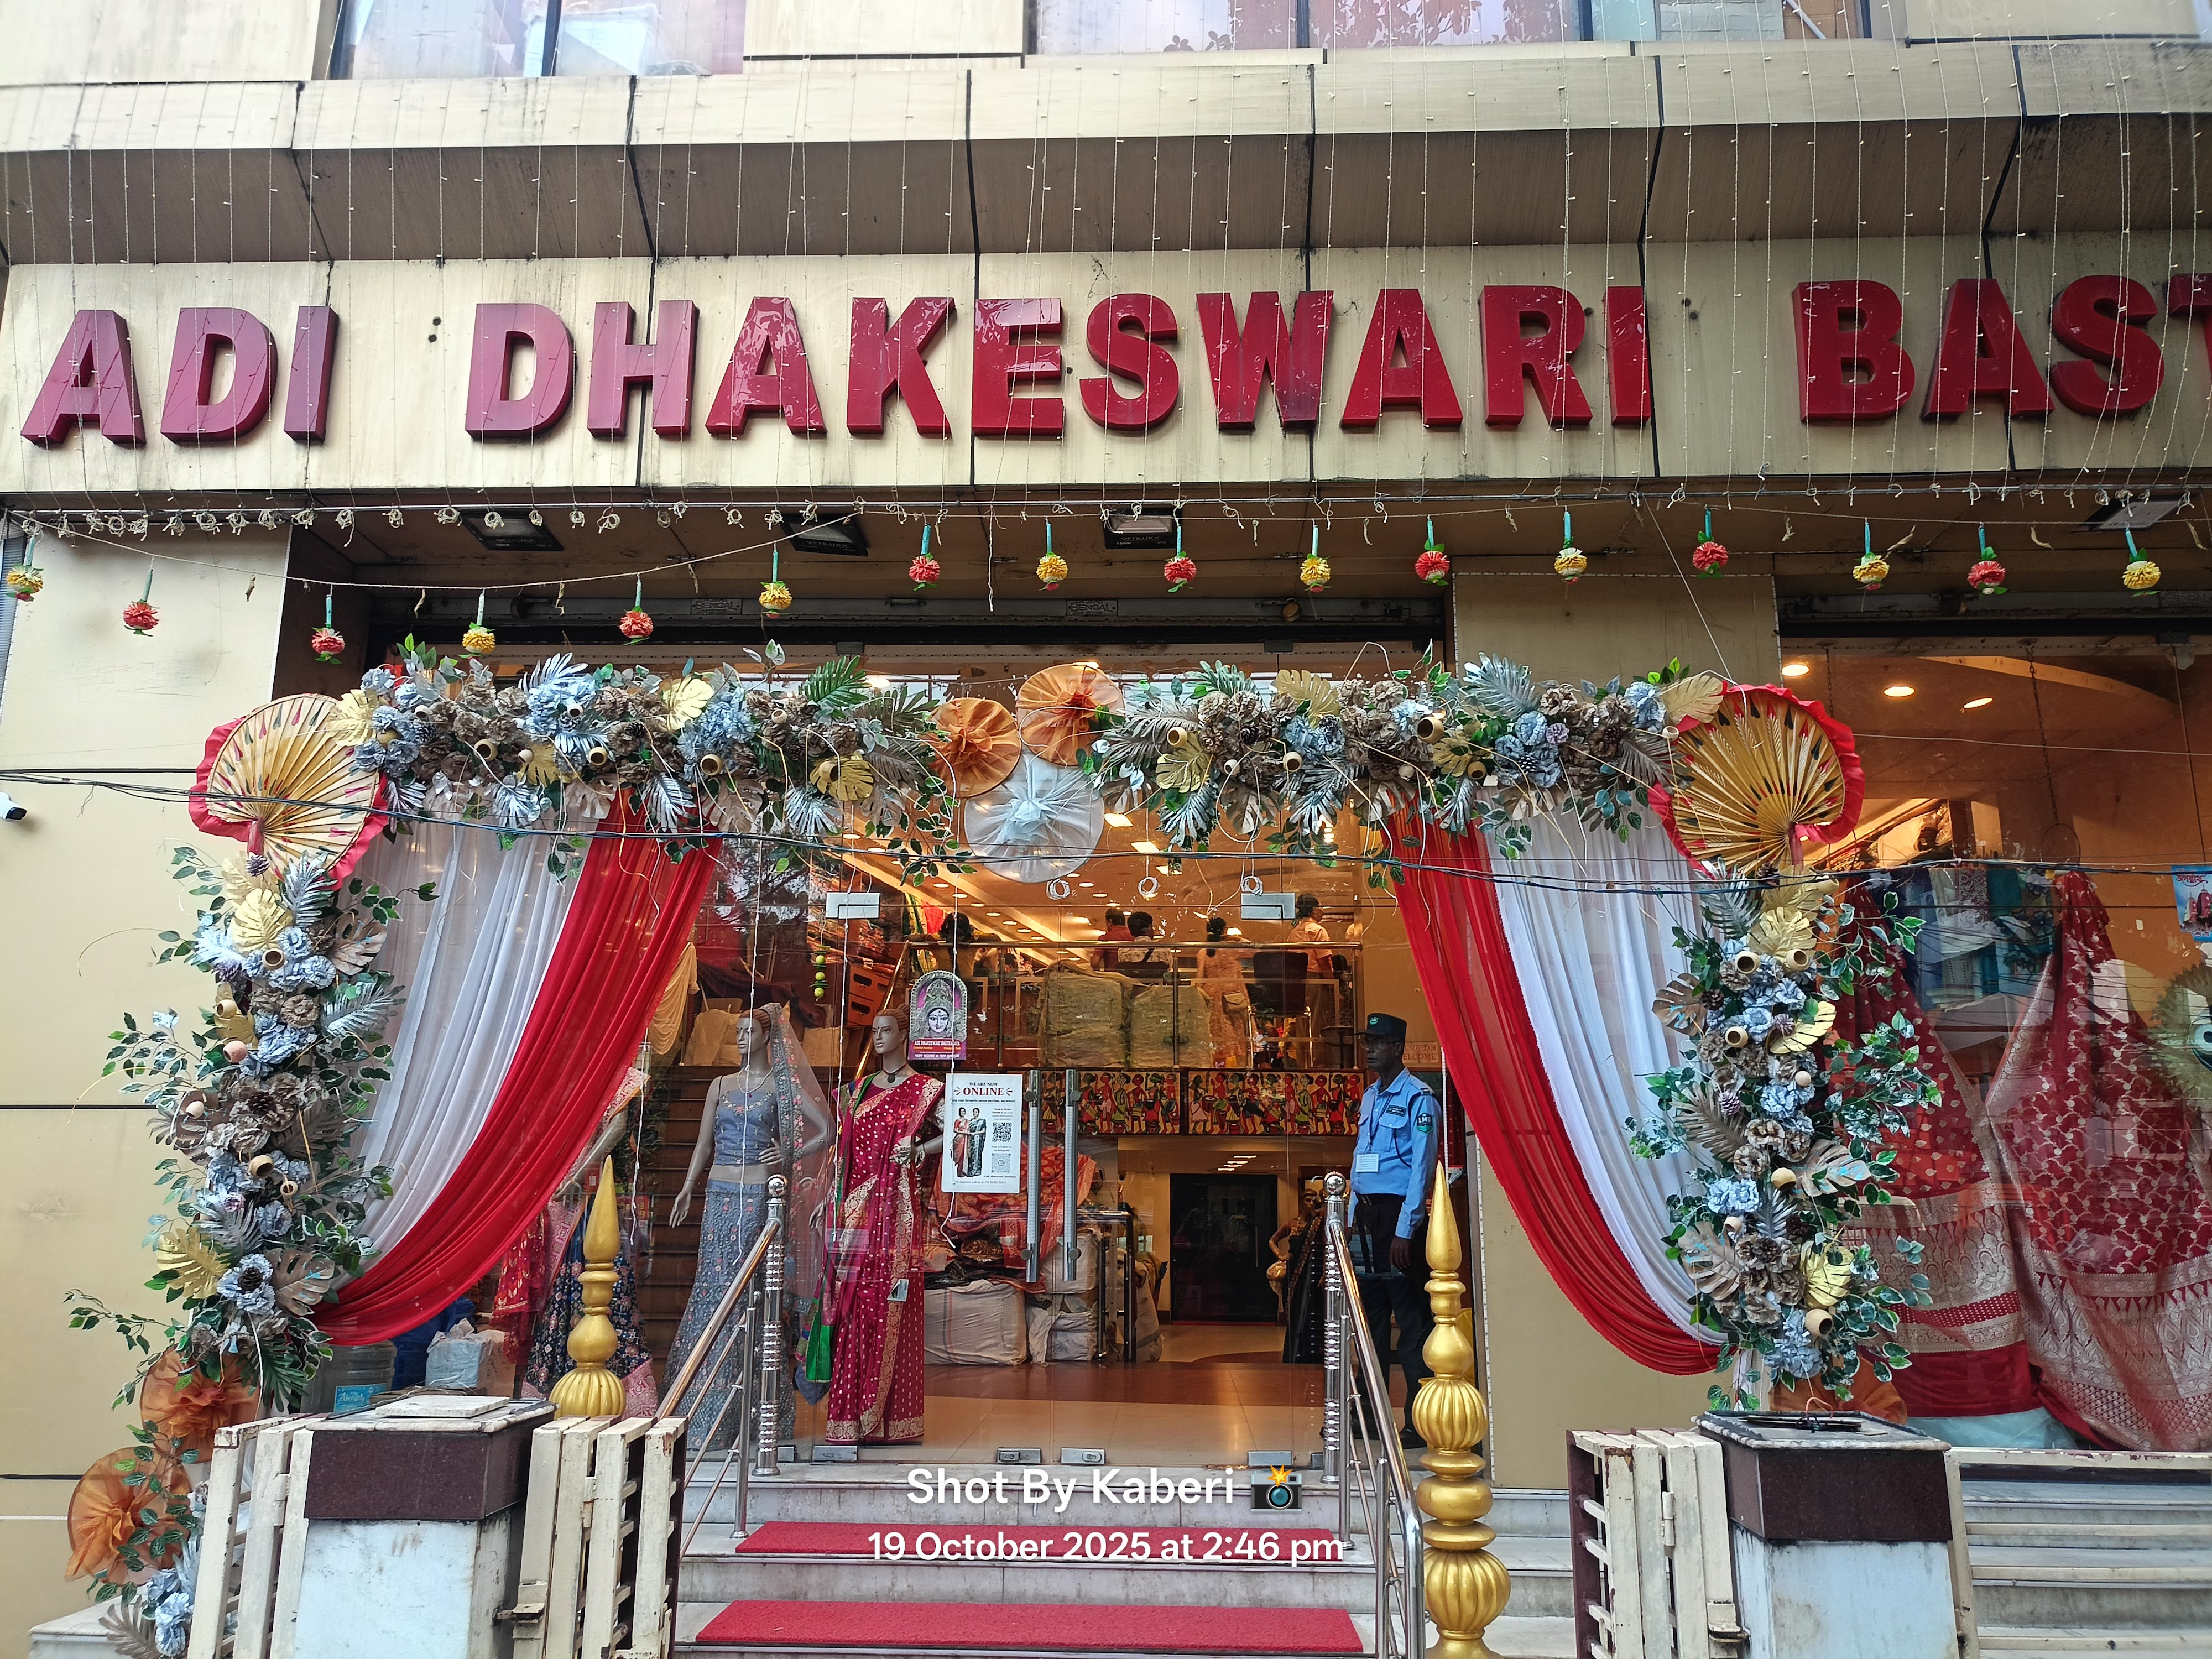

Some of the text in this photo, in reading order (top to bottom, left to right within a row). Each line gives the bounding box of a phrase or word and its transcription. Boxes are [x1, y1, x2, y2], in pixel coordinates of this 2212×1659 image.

[20, 304, 339, 447] ADI
[463, 285, 1652, 442] DHAKESWARI
[963, 1087, 1004, 1095] ONLINE
